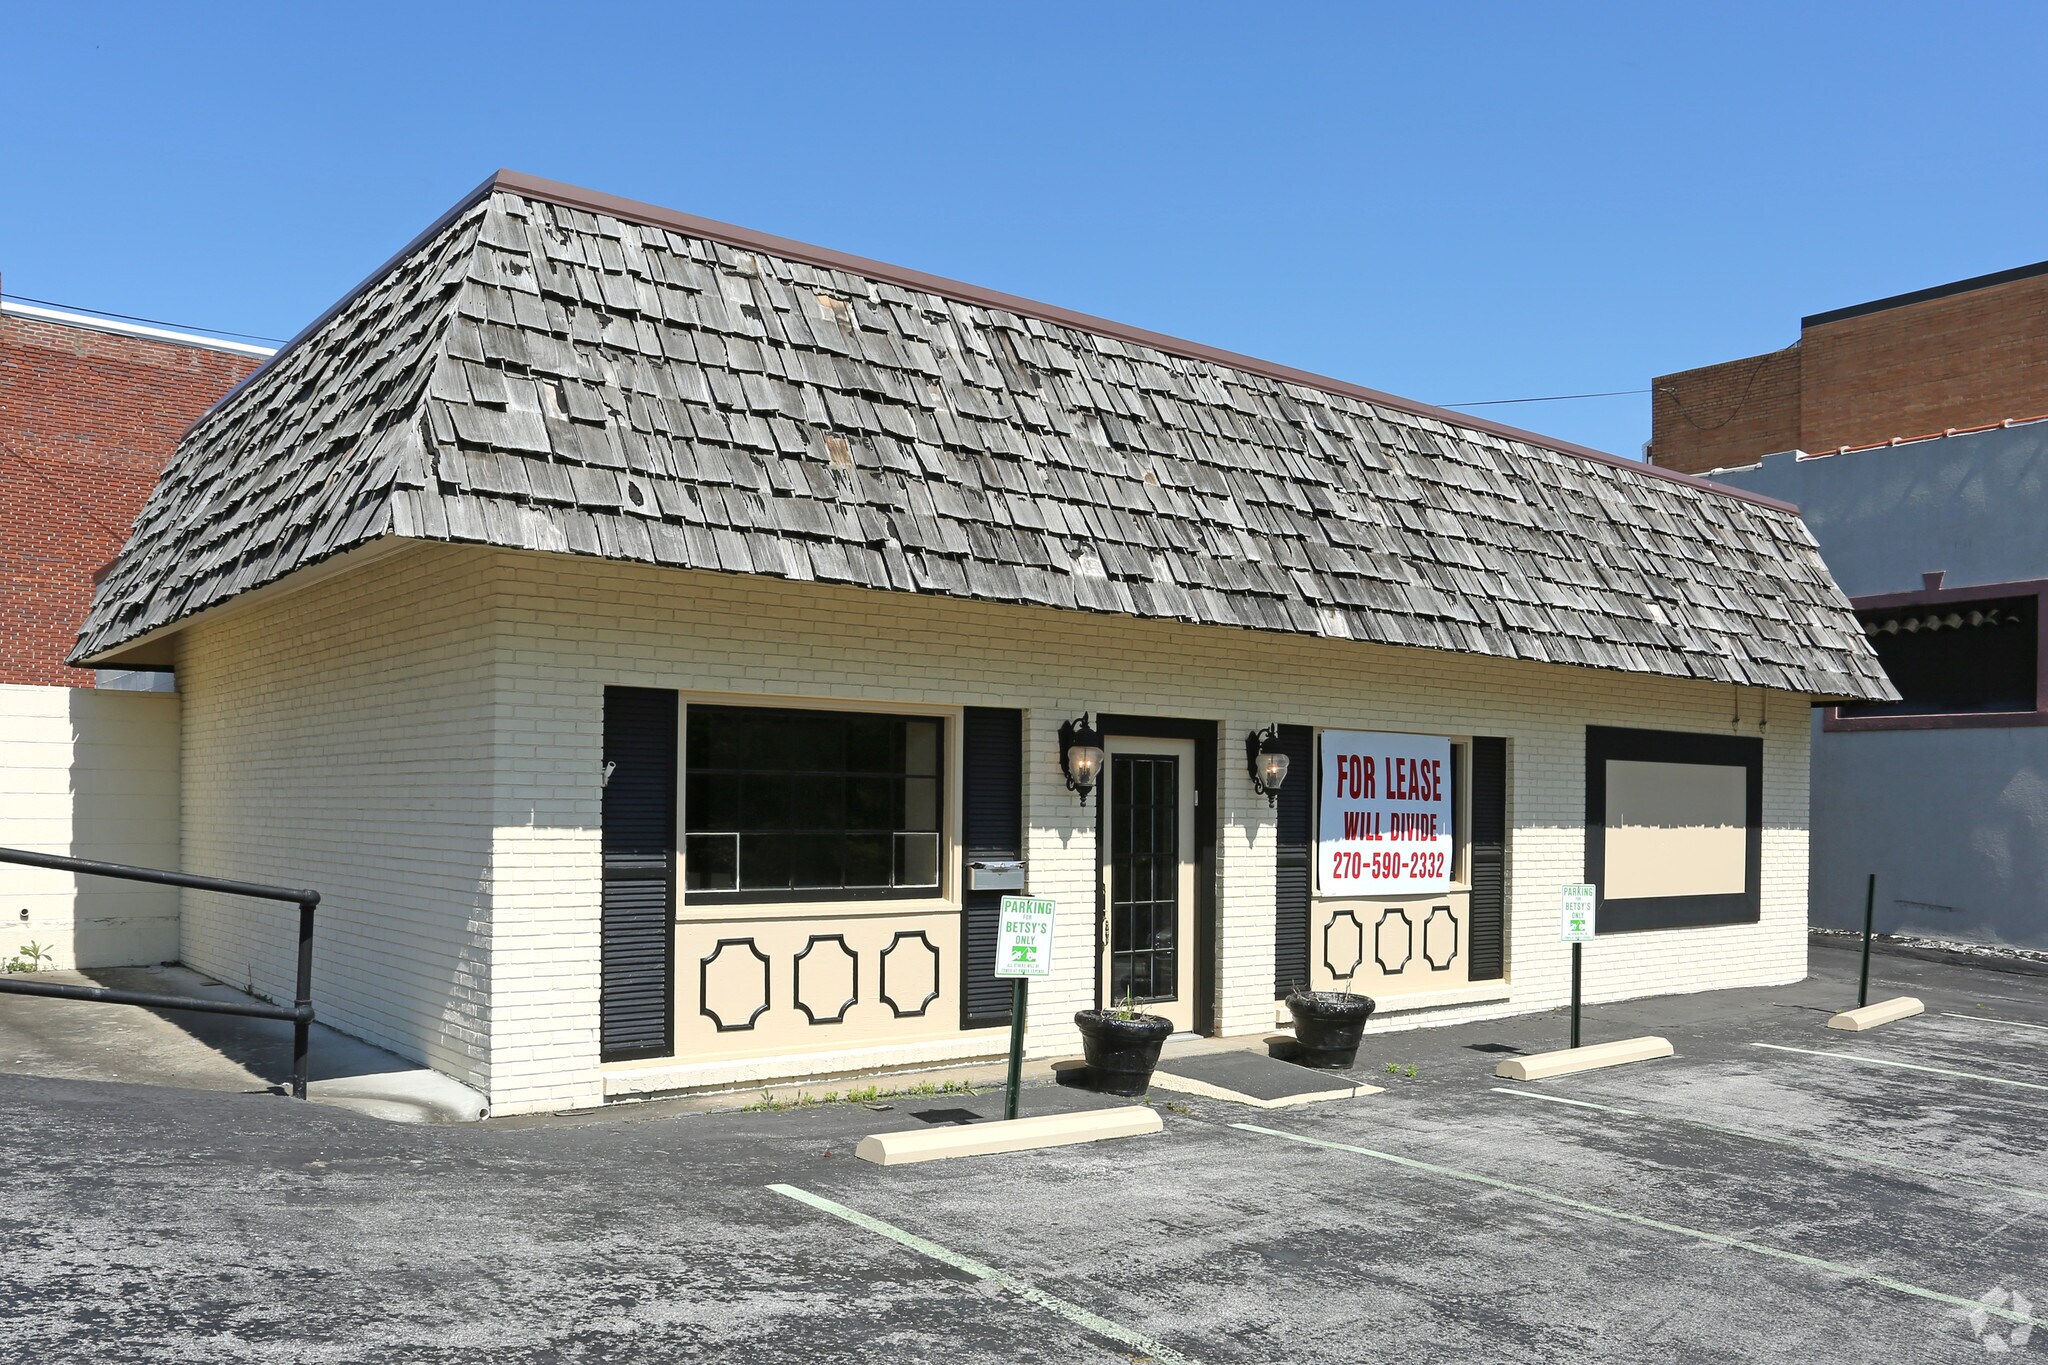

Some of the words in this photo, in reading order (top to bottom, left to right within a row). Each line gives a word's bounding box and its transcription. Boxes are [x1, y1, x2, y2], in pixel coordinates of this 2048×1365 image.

[1337, 754, 1375, 799] FOR
[1385, 757, 1442, 802] LEASE
[1344, 811, 1383, 841] WILL
[1390, 812, 1437, 842] DIVIDE
[1333, 851, 1444, 879] 270-590-2332
[1564, 887, 1593, 896] PARKING
[1004, 900, 1052, 914] PARKING
[1565, 902, 1591, 910] BETSY'S
[1006, 921, 1047, 934] BETSY'S
[1015, 935, 1035, 945] ONLY
